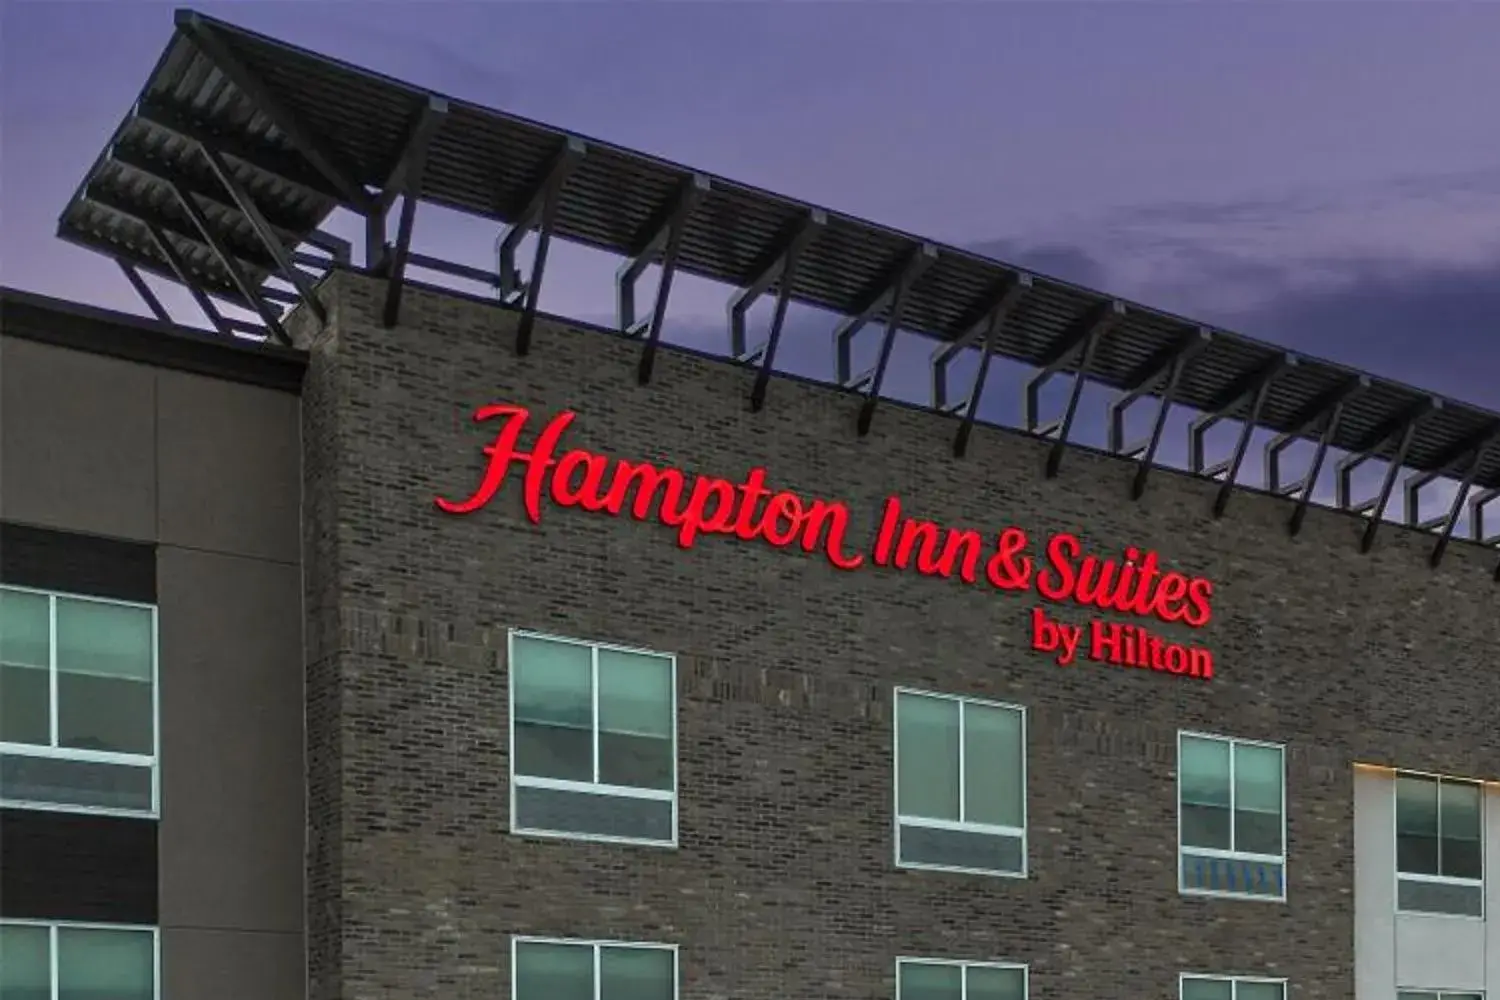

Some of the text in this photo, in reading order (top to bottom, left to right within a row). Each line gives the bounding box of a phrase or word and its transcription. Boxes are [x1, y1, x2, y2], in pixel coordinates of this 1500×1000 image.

[434, 403, 1214, 627] Hampton Inn & Suites
[1032, 607, 1215, 679] by Hilton
